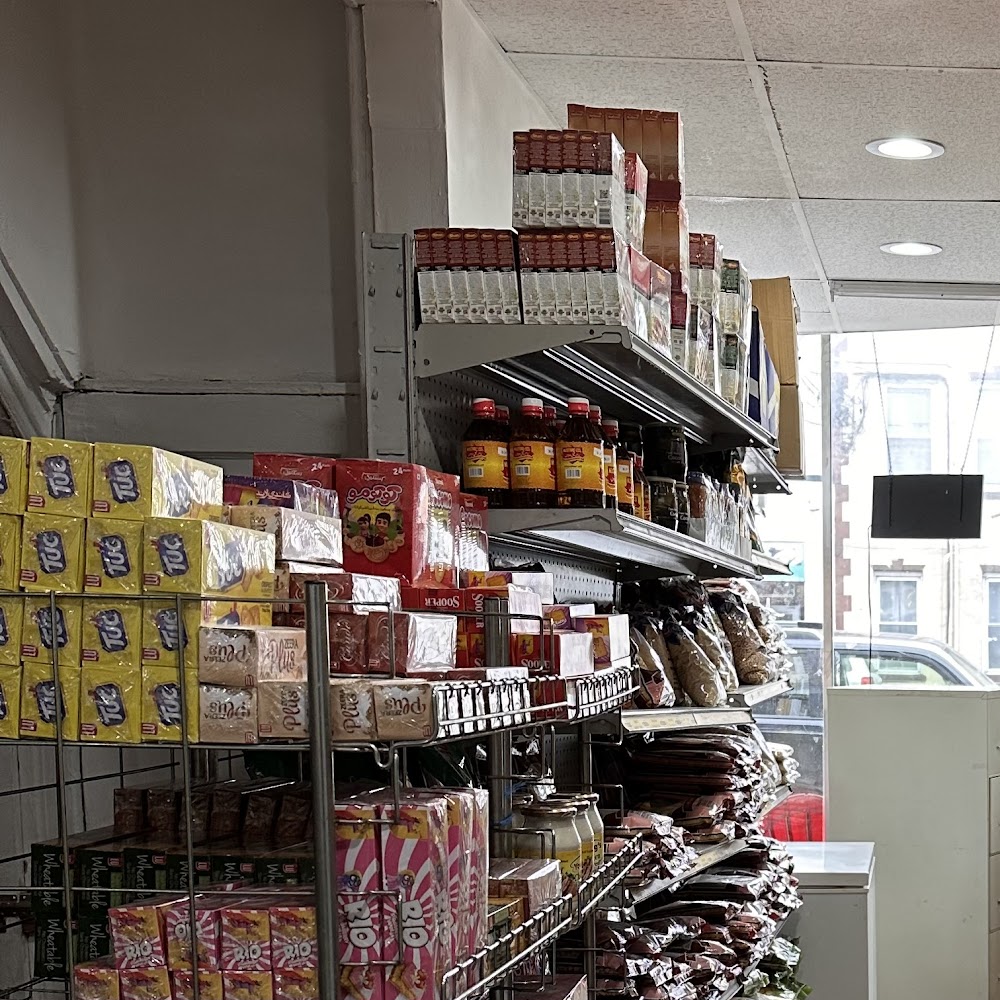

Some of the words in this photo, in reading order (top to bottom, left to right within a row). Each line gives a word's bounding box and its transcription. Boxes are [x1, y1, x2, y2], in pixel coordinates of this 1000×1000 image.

[50, 457, 73, 496] TUC
[112, 463, 137, 501] TUC
[393, 467, 403, 476] 24
[40, 534, 64, 572] TUC
[104, 540, 127, 575] TUC
[161, 538, 187, 575] TUC
[425, 595, 460, 608] SOOPER
[472, 594, 485, 629] SOOER
[101, 613, 125, 649] TUC
[209, 644, 250, 663] Plus
[263, 638, 297, 673] Plus
[100, 687, 123, 725] TUC
[160, 687, 183, 725] TUC
[209, 701, 250, 718] Plus
[283, 690, 301, 731] Plus
[343, 692, 361, 733] Plus
[384, 696, 426, 714] Plus
[40, 853, 60, 907] Wheatble
[44, 919, 64, 972] Wheatable
[124, 940, 154, 960] RIO
[234, 943, 262, 961] RIO
[283, 940, 312, 959] RIO
